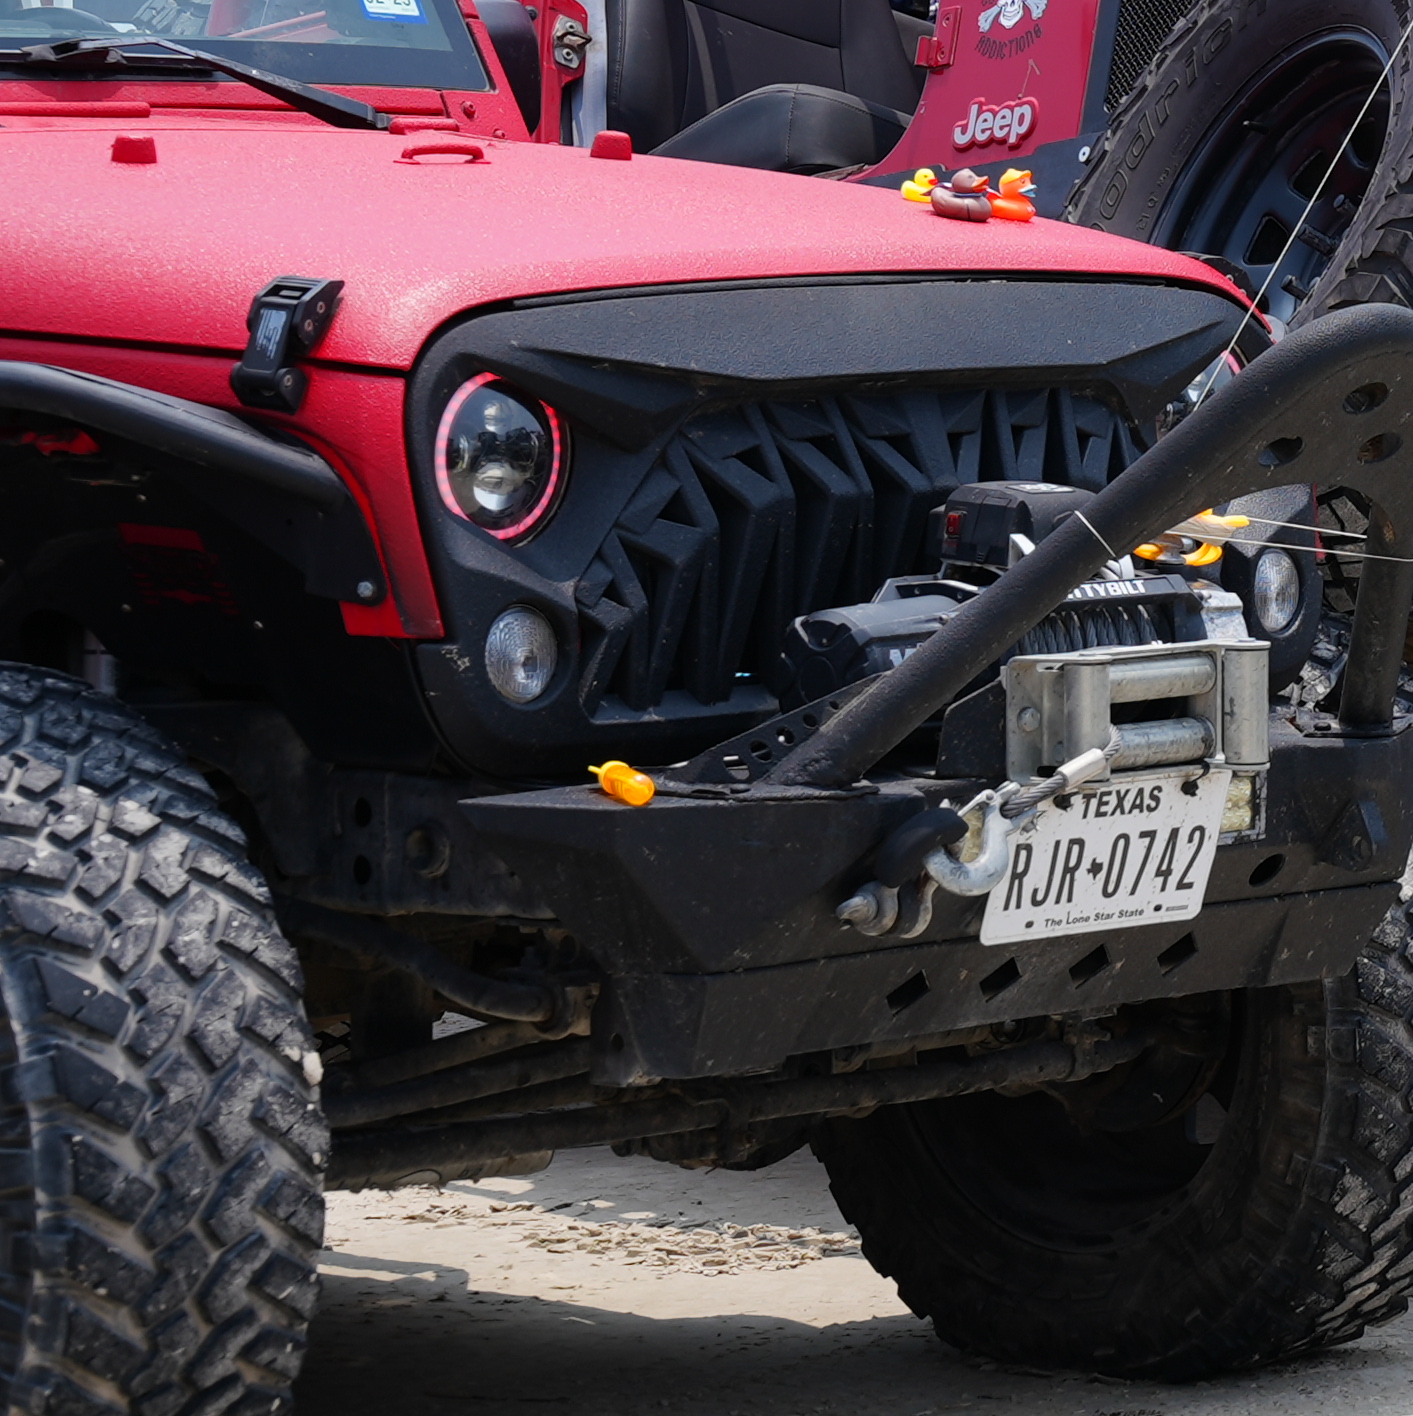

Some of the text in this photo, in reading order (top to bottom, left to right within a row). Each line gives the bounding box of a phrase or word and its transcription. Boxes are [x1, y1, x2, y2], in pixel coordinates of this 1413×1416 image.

[953, 100, 1035, 147] Jeep
[1082, 785, 1163, 820] TEXAS
[1044, 906, 1144, 928] The Lone Star State
